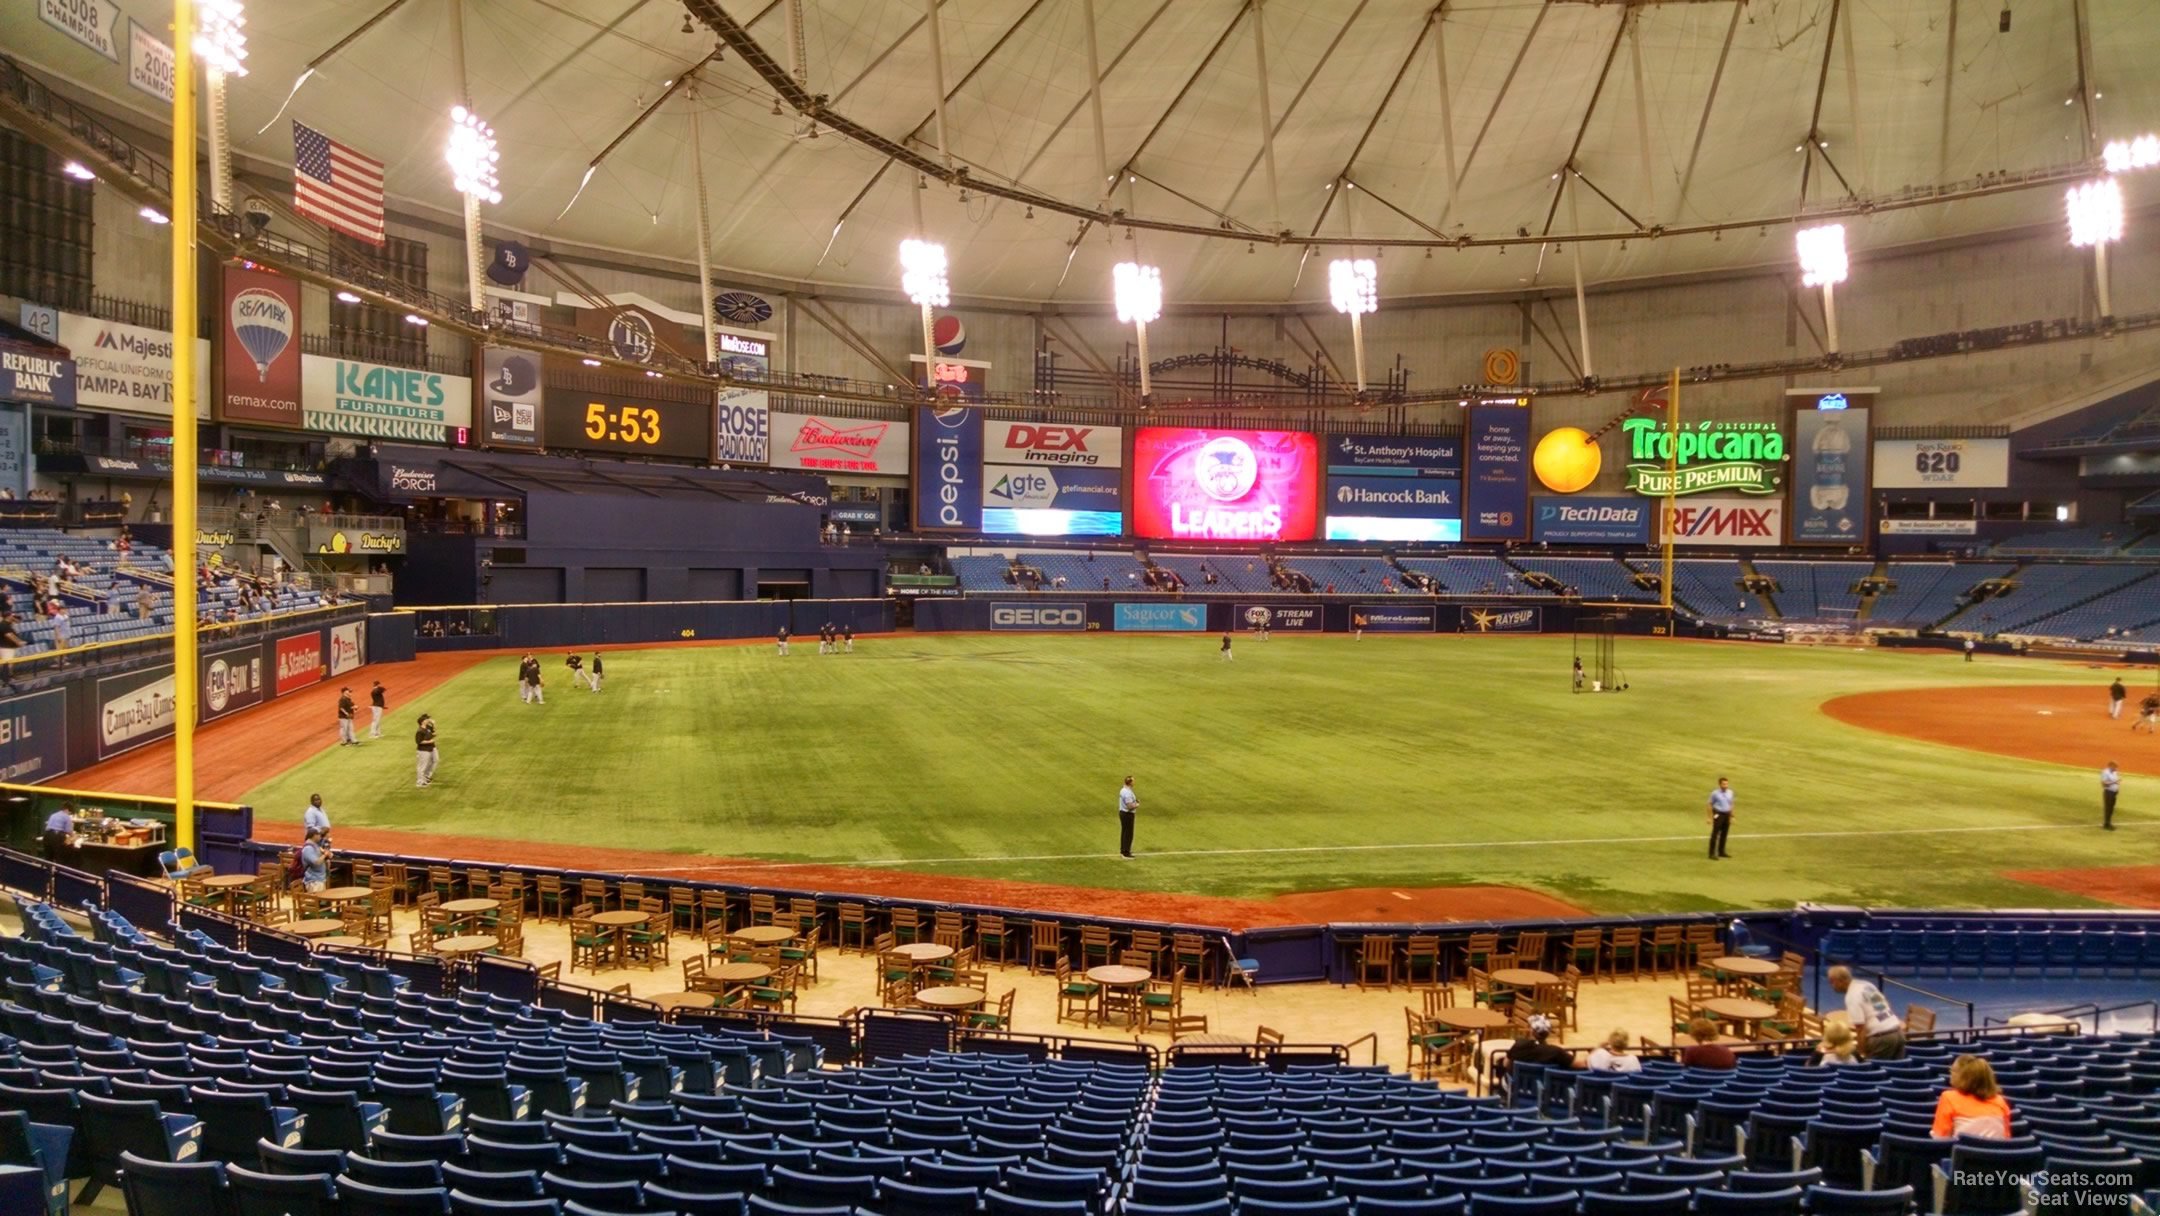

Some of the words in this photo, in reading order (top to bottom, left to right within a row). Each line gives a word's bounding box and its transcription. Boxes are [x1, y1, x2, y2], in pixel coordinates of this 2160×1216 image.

[46, 2, 108, 52] CHAMPIONS
[134, 67, 175, 99] CHAMPIO
[239, 300, 286, 324] RE/MAX
[29, 311, 50, 335] 42
[121, 333, 174, 360] Majesti
[3, 352, 63, 378] REPUBLIC
[76, 356, 119, 372] OFFICIAL
[121, 364, 164, 378] UNIFORM
[16, 372, 52, 393] BANK
[76, 375, 129, 396] TAMPA
[133, 382, 161, 400] BAY
[336, 361, 445, 407] KANE'S
[228, 394, 297, 411] remax.com
[340, 400, 439, 420] FURNITURE
[516, 408, 532, 418] NEW
[516, 416, 532, 426] ERA
[719, 404, 767, 437] ROSE
[585, 403, 661, 444] 5:53
[1489, 425, 1510, 433] home
[800, 427, 878, 447] Budweiser
[1005, 424, 1094, 452] DEX
[1622, 418, 1784, 465] Tropicana
[719, 435, 768, 463] RADIOLOGY
[1025, 450, 1098, 464] imaging
[1355, 446, 1366, 455] St.
[1368, 446, 1413, 458] Anthony's
[1415, 448, 1453, 459] Hospital
[1478, 443, 1506, 454] keeping
[1508, 445, 1521, 453] you
[1479, 454, 1519, 462] connected.
[1916, 452, 1960, 473] 620
[293, 473, 324, 483] Ballpark
[394, 468, 435, 479] Budweiser
[937, 437, 964, 526] pepsi
[1639, 473, 1682, 491] PURE
[1685, 467, 1762, 489] PREMIUM
[392, 477, 436, 491] PORCH
[1013, 473, 1046, 495] gte
[1061, 484, 1118, 495] gtefinancial.org
[1355, 488, 1413, 503] Hancock
[1415, 489, 1450, 504] Bank
[838, 511, 856, 519] GRAB
[1171, 501, 1283, 538] LEADERS
[1662, 506, 1773, 537] RE/MAX
[196, 529, 234, 549] Ducky's
[361, 532, 400, 552] Ducky's
[994, 608, 1083, 625] GEICO
[1123, 605, 1174, 622] Sagicor
[1251, 609, 1265, 618] FOX
[1276, 610, 1313, 618] STREAM
[1286, 618, 1304, 626] LIVE
[681, 629, 695, 637] 404
[1087, 622, 1100, 630] 370
[1652, 626, 1666, 634] 322
[211, 669, 226, 690] FOX
[230, 665, 248, 695] SUN
[106, 710, 136, 735] Tampa
[136, 699, 153, 725] Bay
